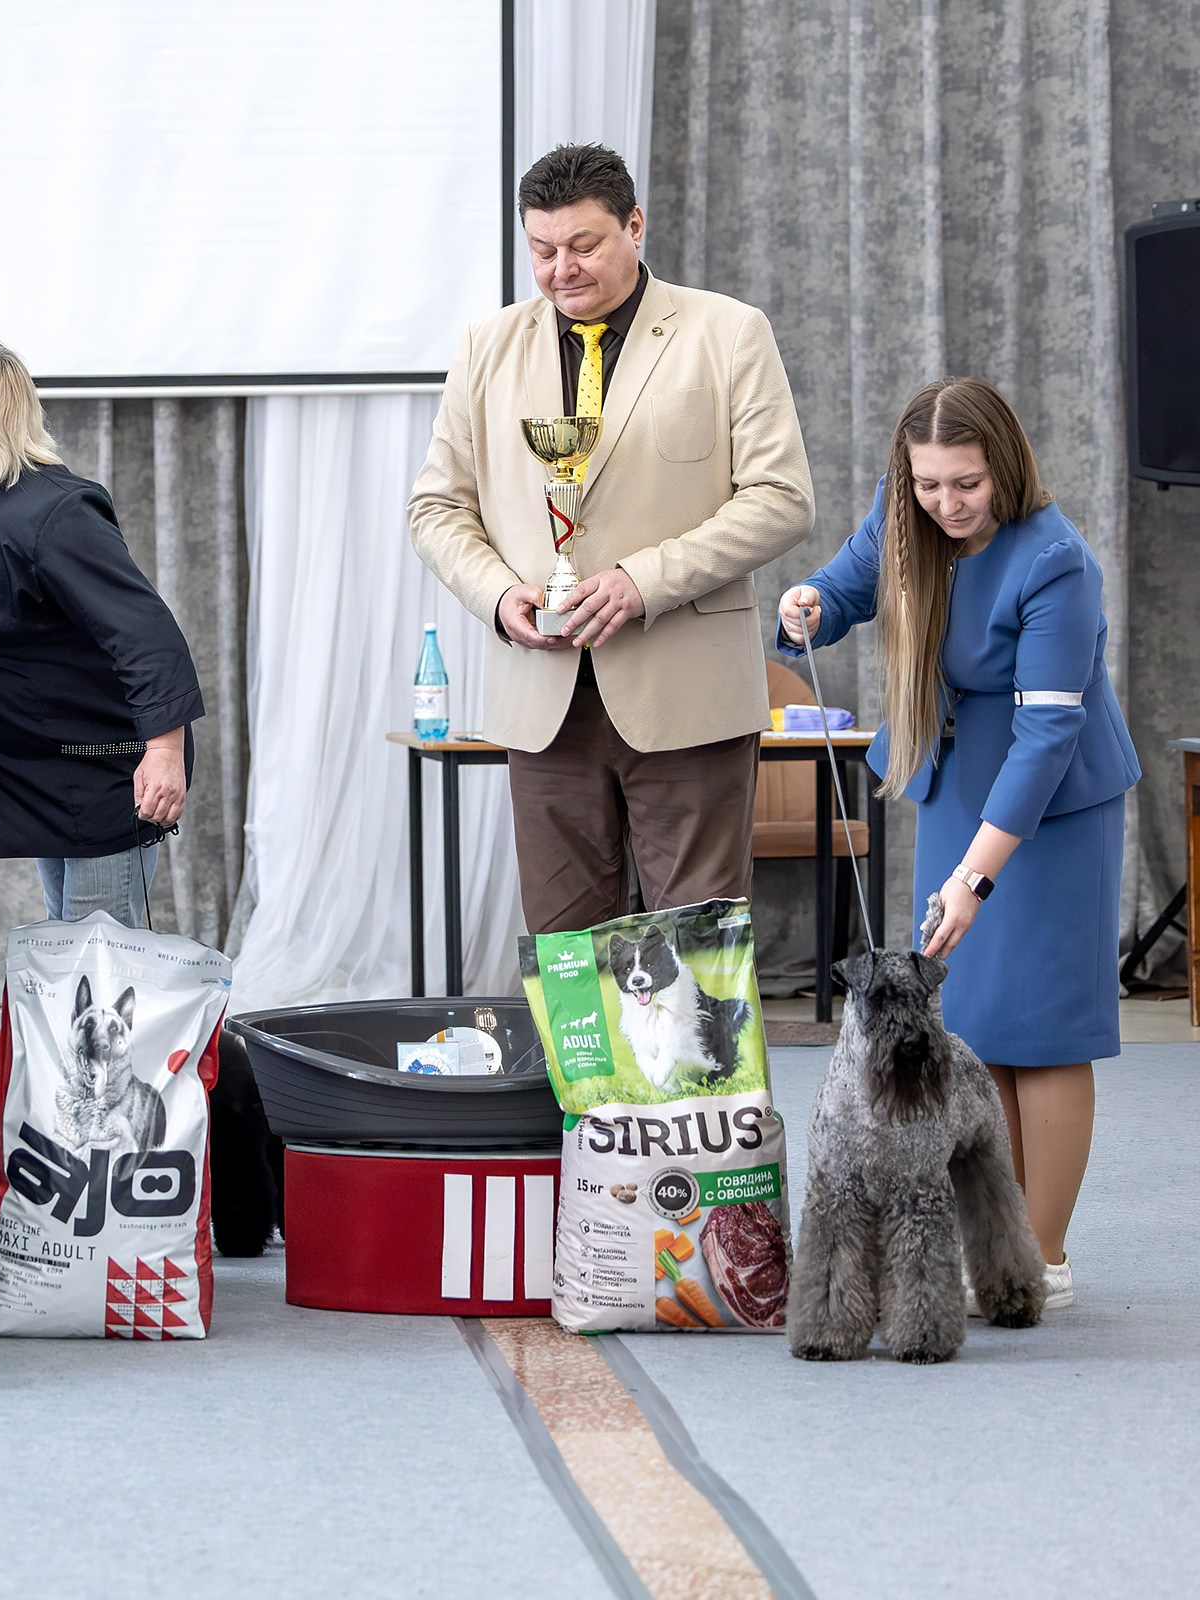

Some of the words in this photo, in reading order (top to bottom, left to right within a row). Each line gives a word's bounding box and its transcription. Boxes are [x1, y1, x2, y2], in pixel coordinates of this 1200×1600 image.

[57, 938, 74, 946] VIEW
[107, 940, 146, 953] BUCKWHEAT
[157, 952, 201, 966] WHEAT/CORN
[547, 959, 589, 973] PREMIUM
[559, 969, 579, 979] FOOD
[563, 1033, 601, 1050] ADULT
[577, 1115, 590, 1150] PREMI
[588, 1106, 764, 1157] SIRIUS
[576, 1178, 589, 1194] 15
[590, 1184, 604, 1195] кг
[717, 1170, 774, 1188] ГОВЯДИНА
[657, 1185, 688, 1198] 40%
[717, 1184, 775, 1200] ОВОЩАМИ
[22, 1223, 42, 1237] LINE
[119, 1223, 157, 1231] technology
[41, 1240, 96, 1261] ADULT
